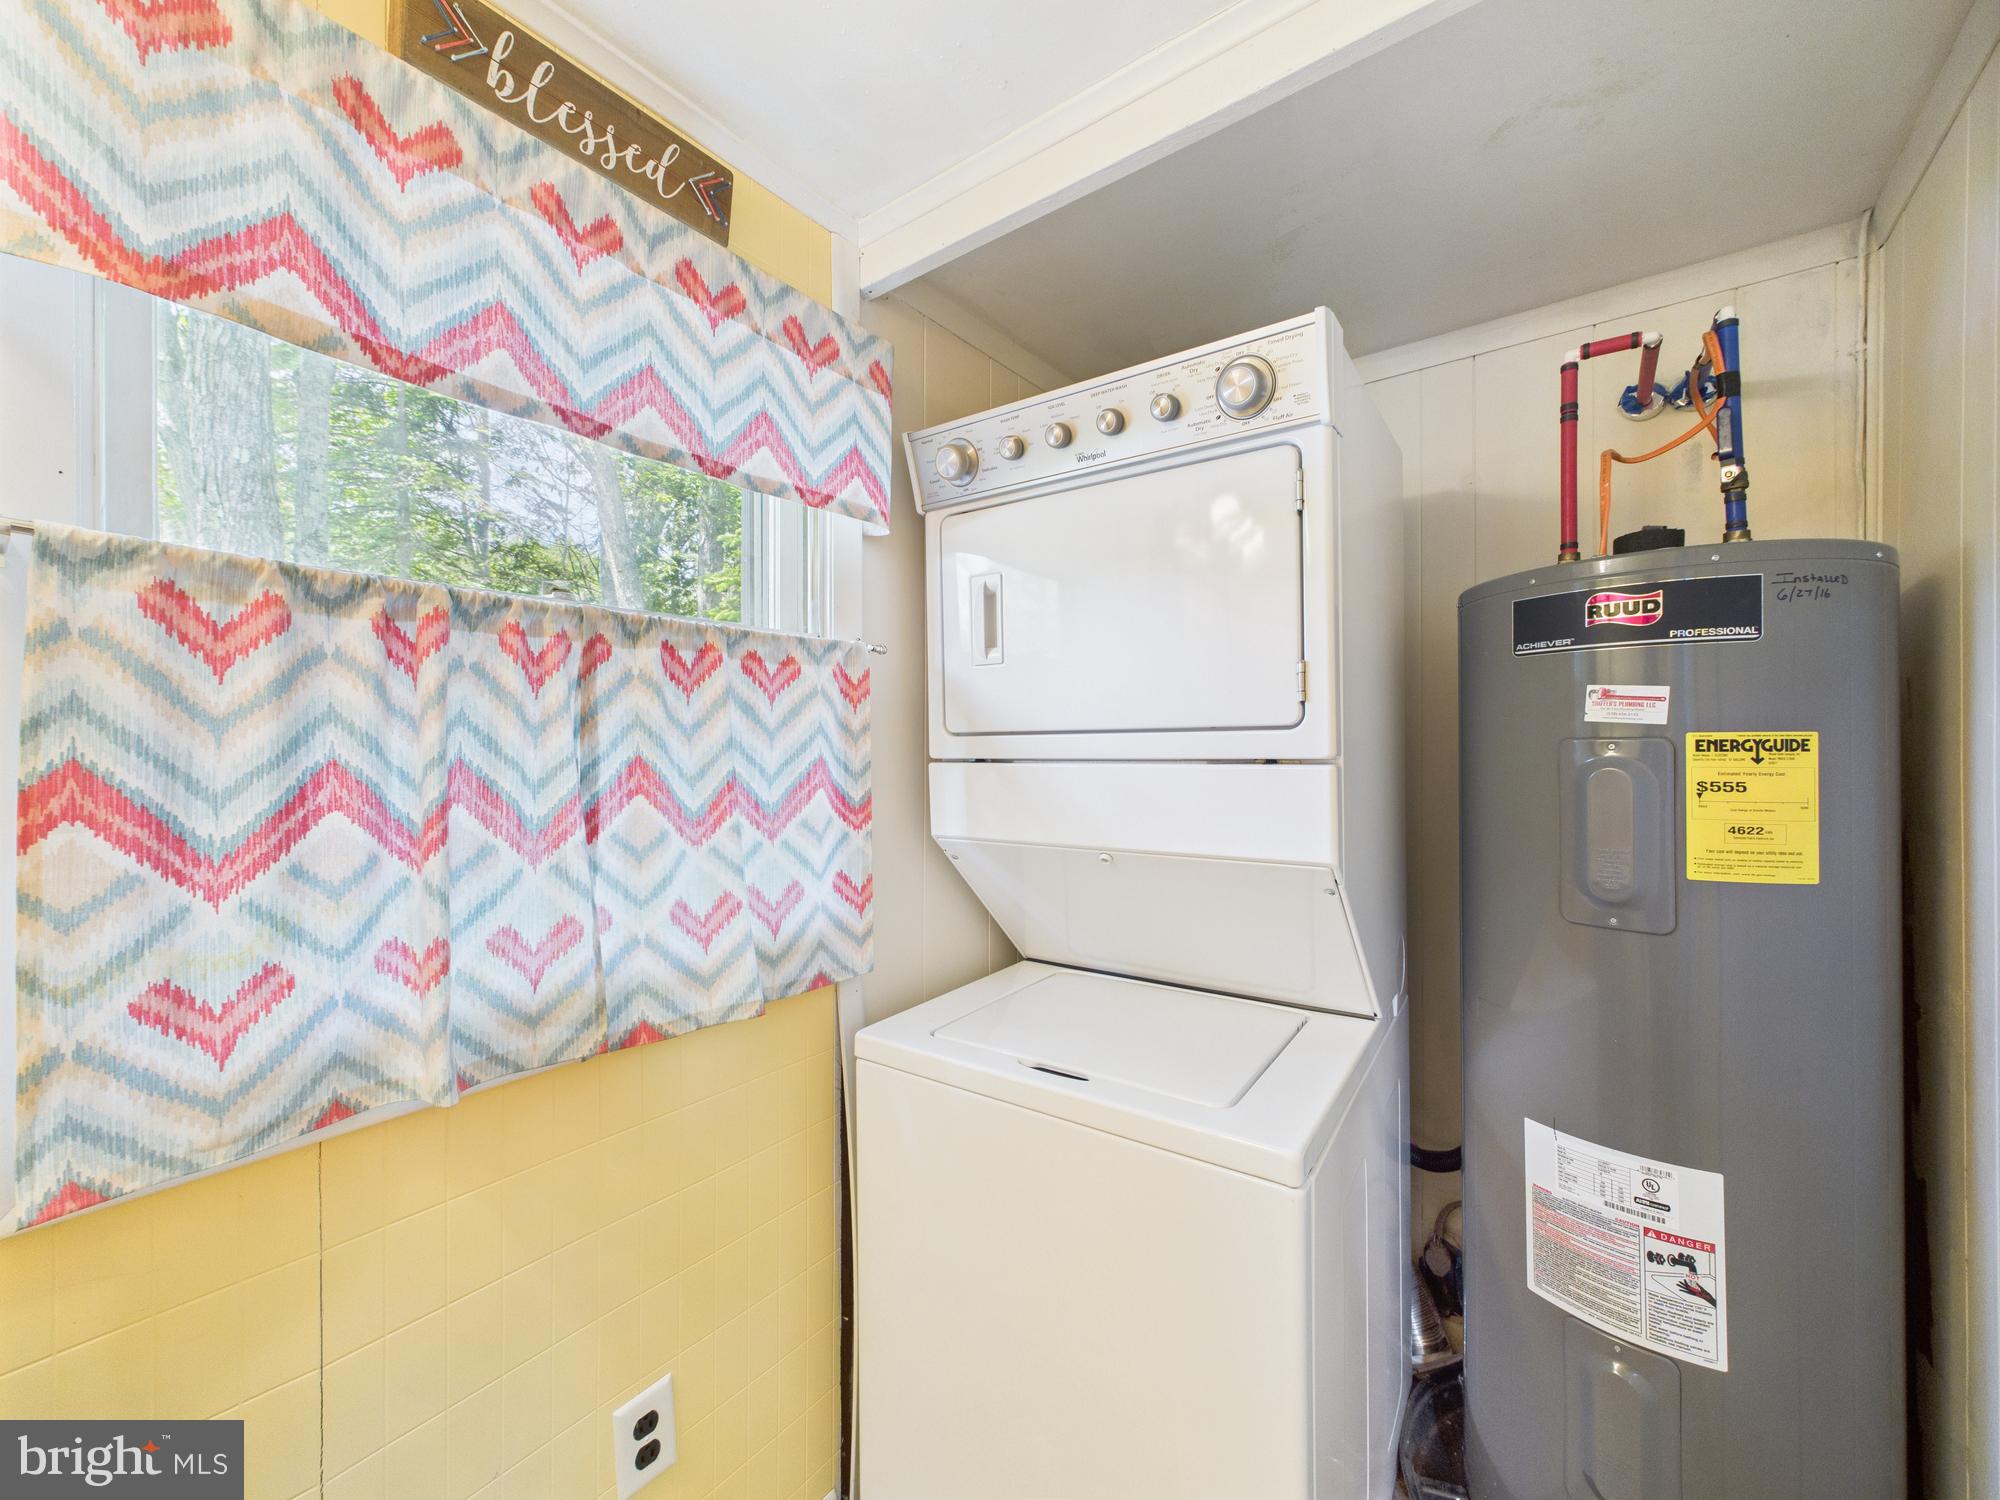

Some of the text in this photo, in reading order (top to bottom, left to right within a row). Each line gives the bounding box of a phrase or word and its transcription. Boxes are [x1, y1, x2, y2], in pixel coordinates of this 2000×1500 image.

[487, 31, 685, 198] blessed
[1285, 331, 1304, 342] Drying
[1076, 450, 1107, 463] Whirlpool
[1777, 585, 1831, 603] 6/27/16
[1586, 599, 1662, 620] RUUD
[1669, 626, 1758, 638] PROFESSIONAL
[1695, 738, 1811, 754] ENERGYGUIDE
[1696, 781, 1747, 793] $555
[1727, 826, 1764, 835] 4622
[1660, 1233, 1711, 1252] DANGER
